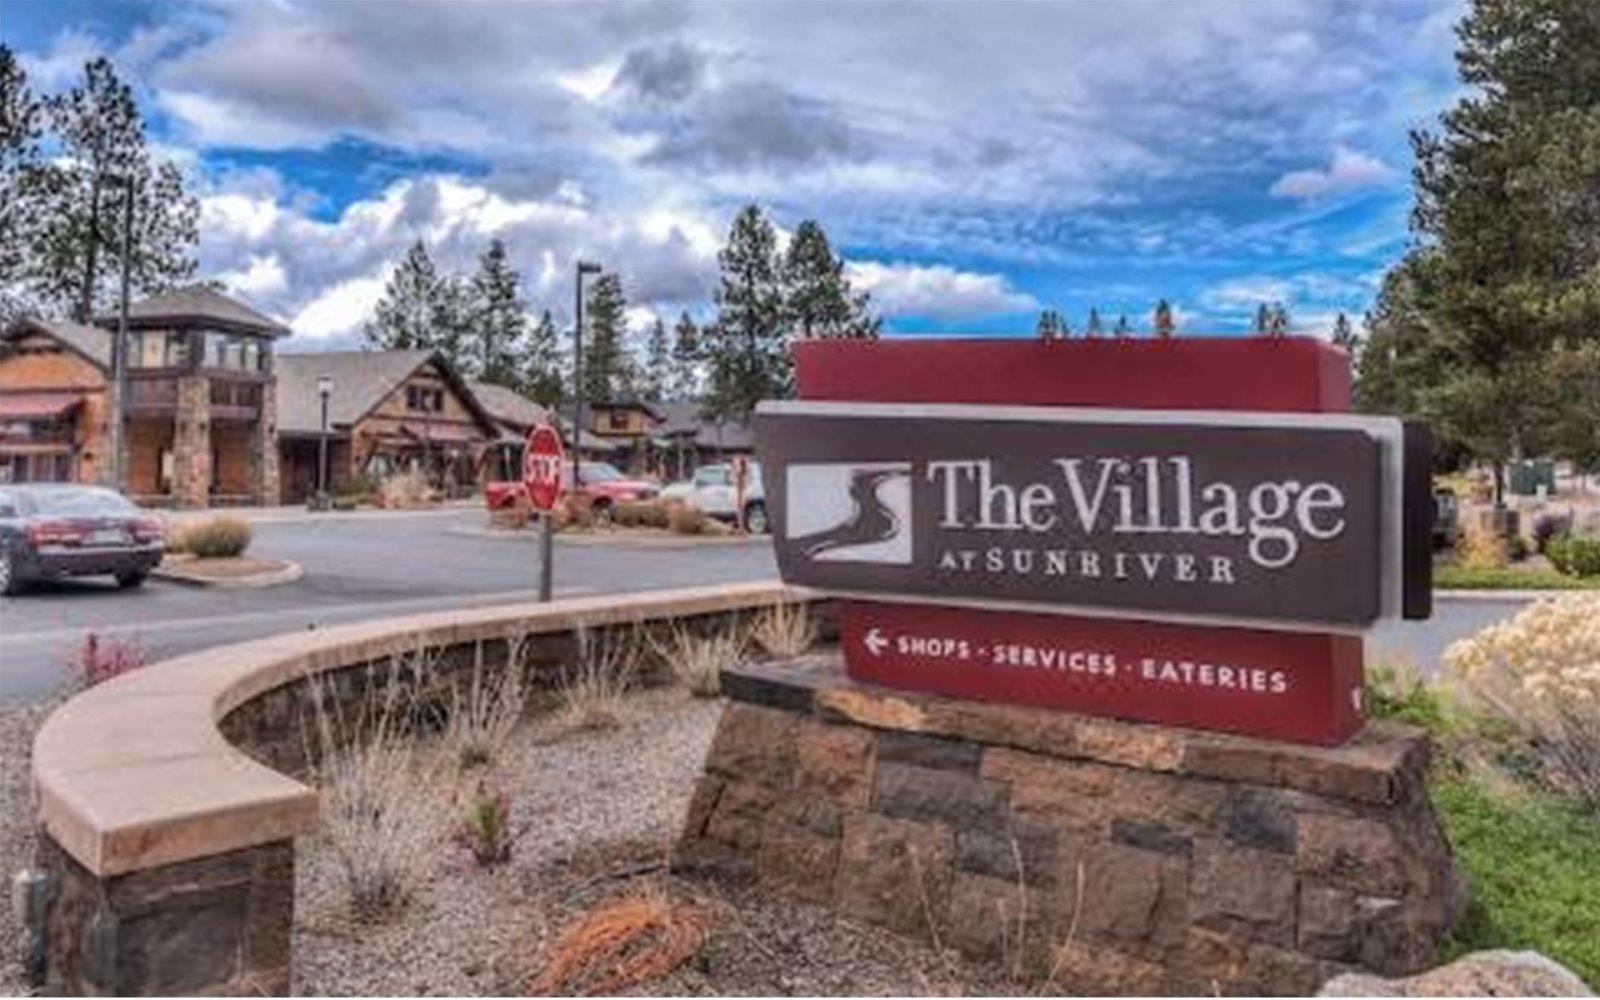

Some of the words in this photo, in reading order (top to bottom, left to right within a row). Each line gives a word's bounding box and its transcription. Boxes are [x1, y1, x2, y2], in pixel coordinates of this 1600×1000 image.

[526, 453, 560, 484] STOP
[940, 551, 977, 571] AT
[985, 547, 1235, 584] SUNRIVER
[897, 635, 970, 659] SHOPS
[992, 644, 1117, 676] SERVICES
[1141, 657, 1287, 693] EATERIES
